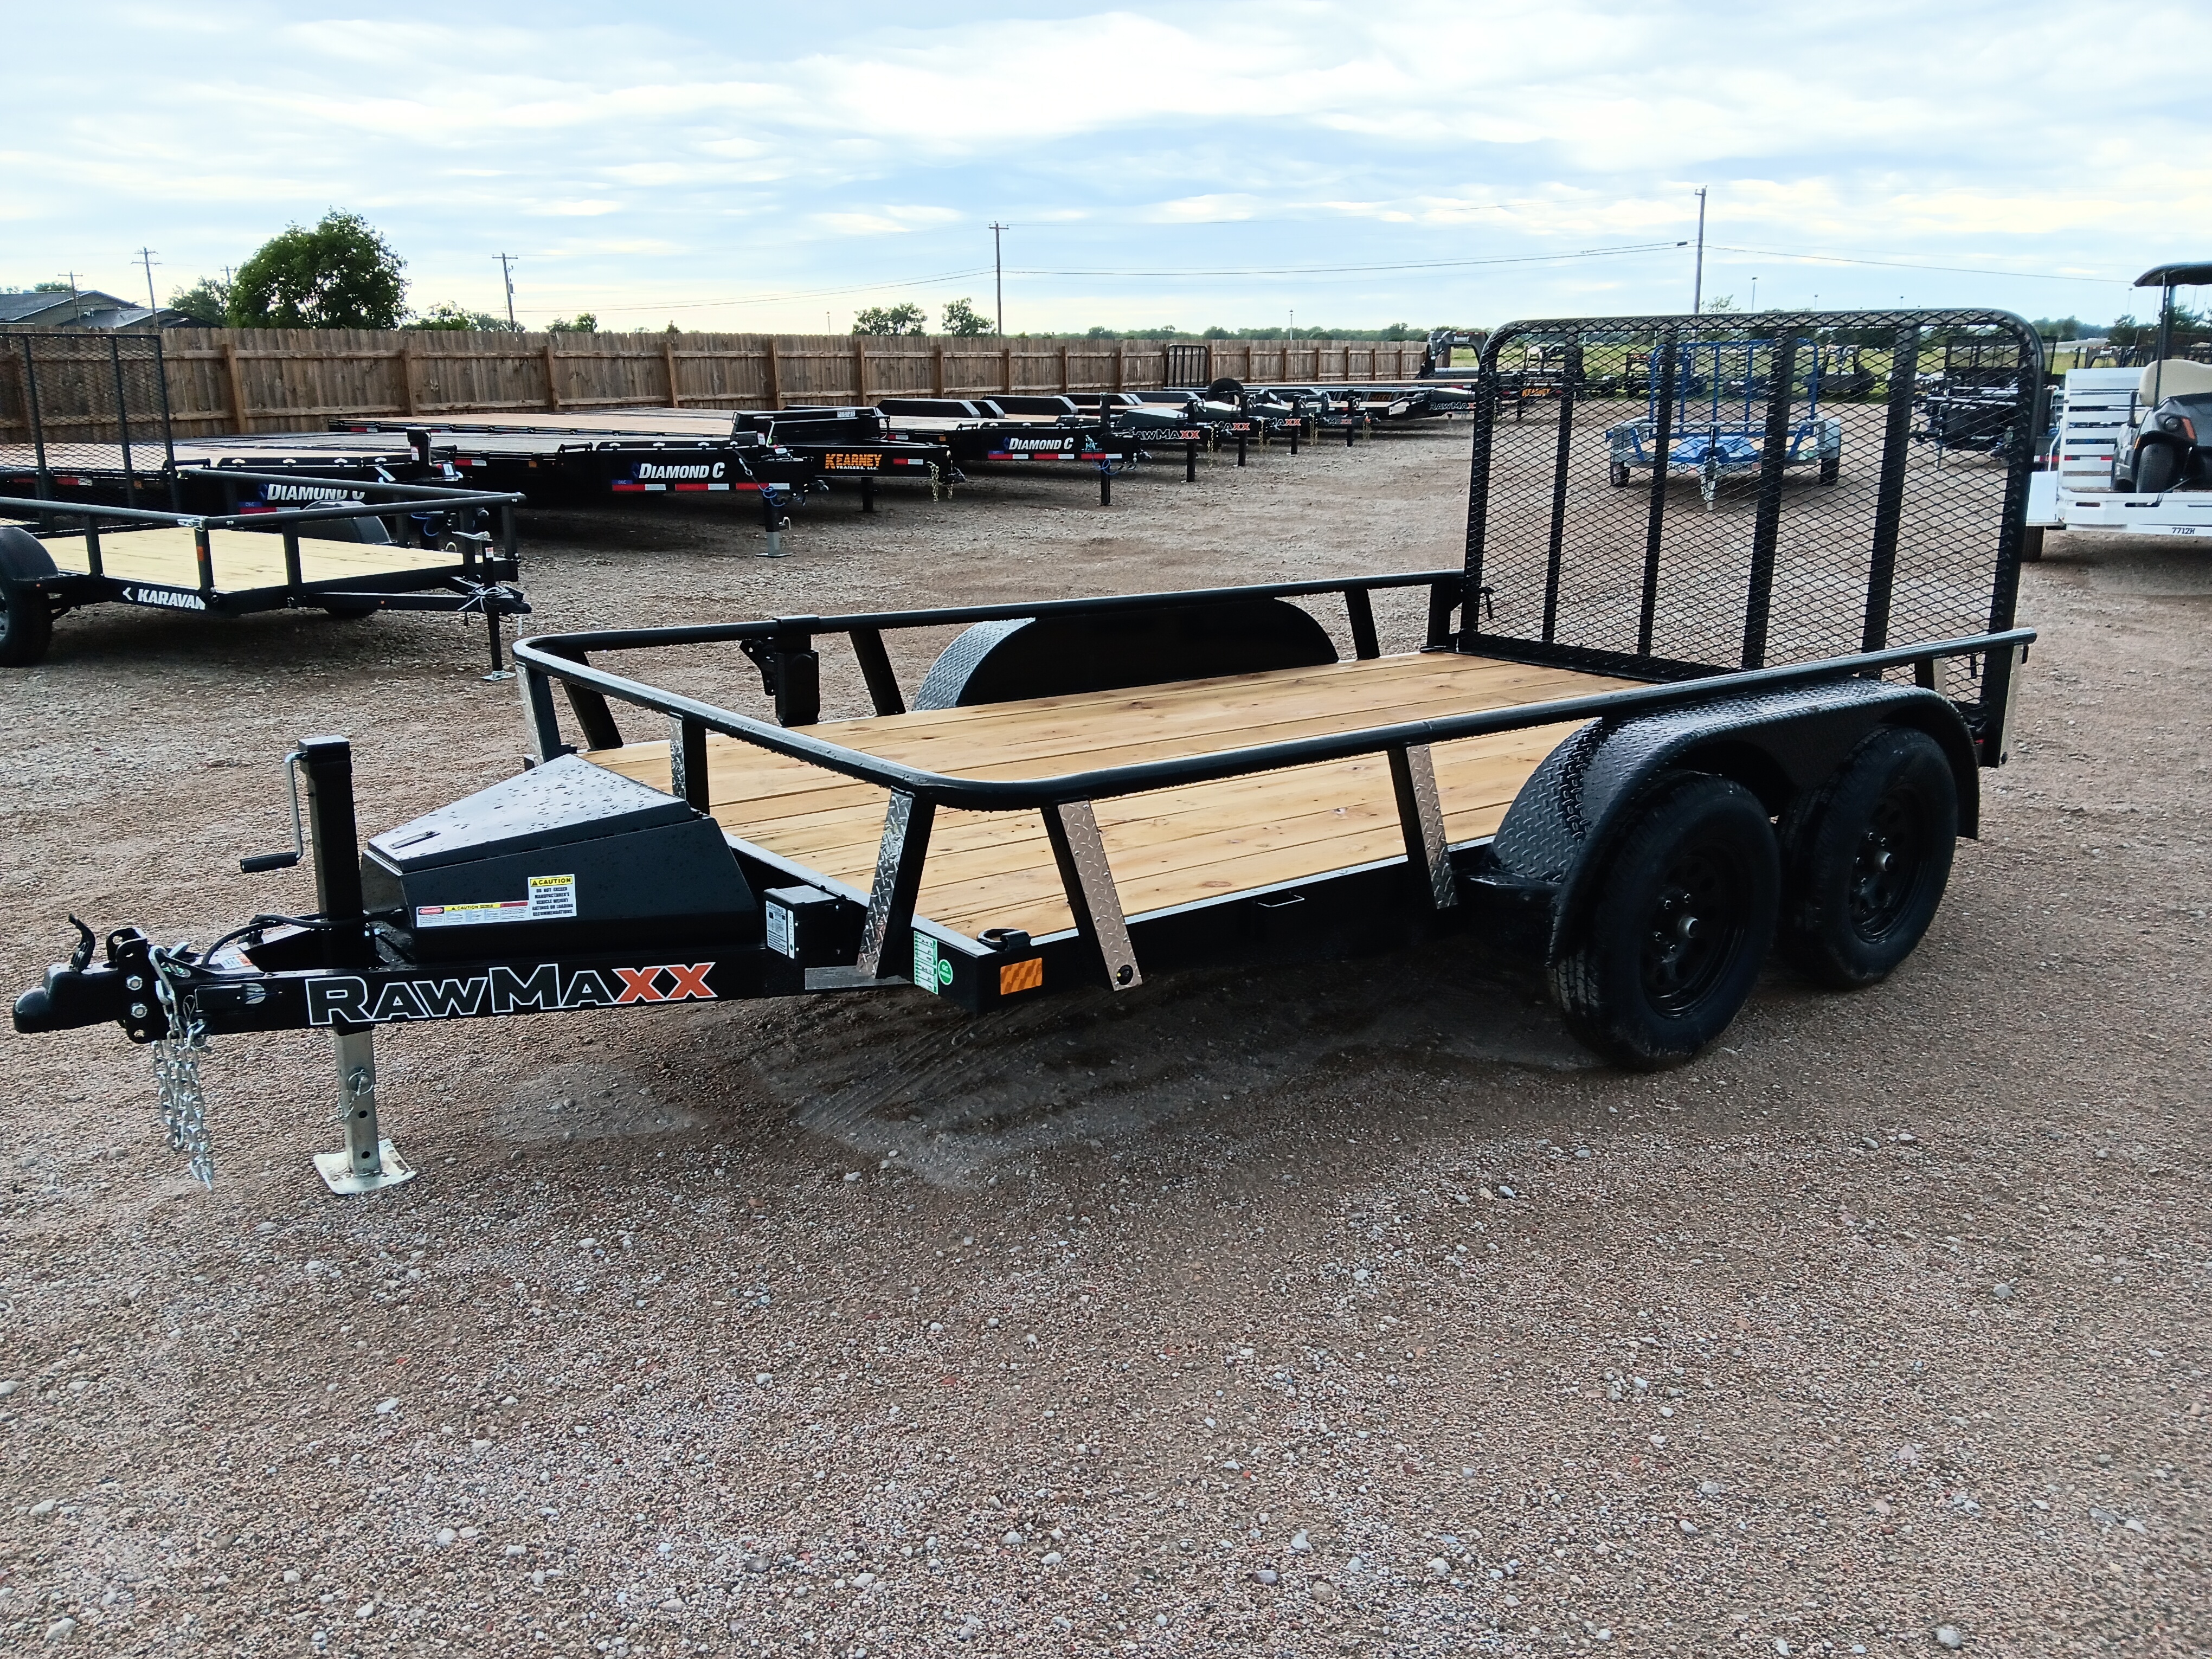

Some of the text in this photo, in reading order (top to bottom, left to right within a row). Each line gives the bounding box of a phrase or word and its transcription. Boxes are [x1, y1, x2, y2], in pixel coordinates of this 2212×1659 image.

[1429, 401, 1476, 410] RAWMAX
[1133, 429, 1200, 440] AWMAXX
[1008, 438, 1062, 450] DIAMOND
[1064, 437, 1074, 449] C
[825, 453, 882, 469] KEARNEY
[639, 462, 725, 479] DIAMOND C
[137, 588, 206, 610] KARAVAN
[305, 962, 718, 1025] RAWMAXX
